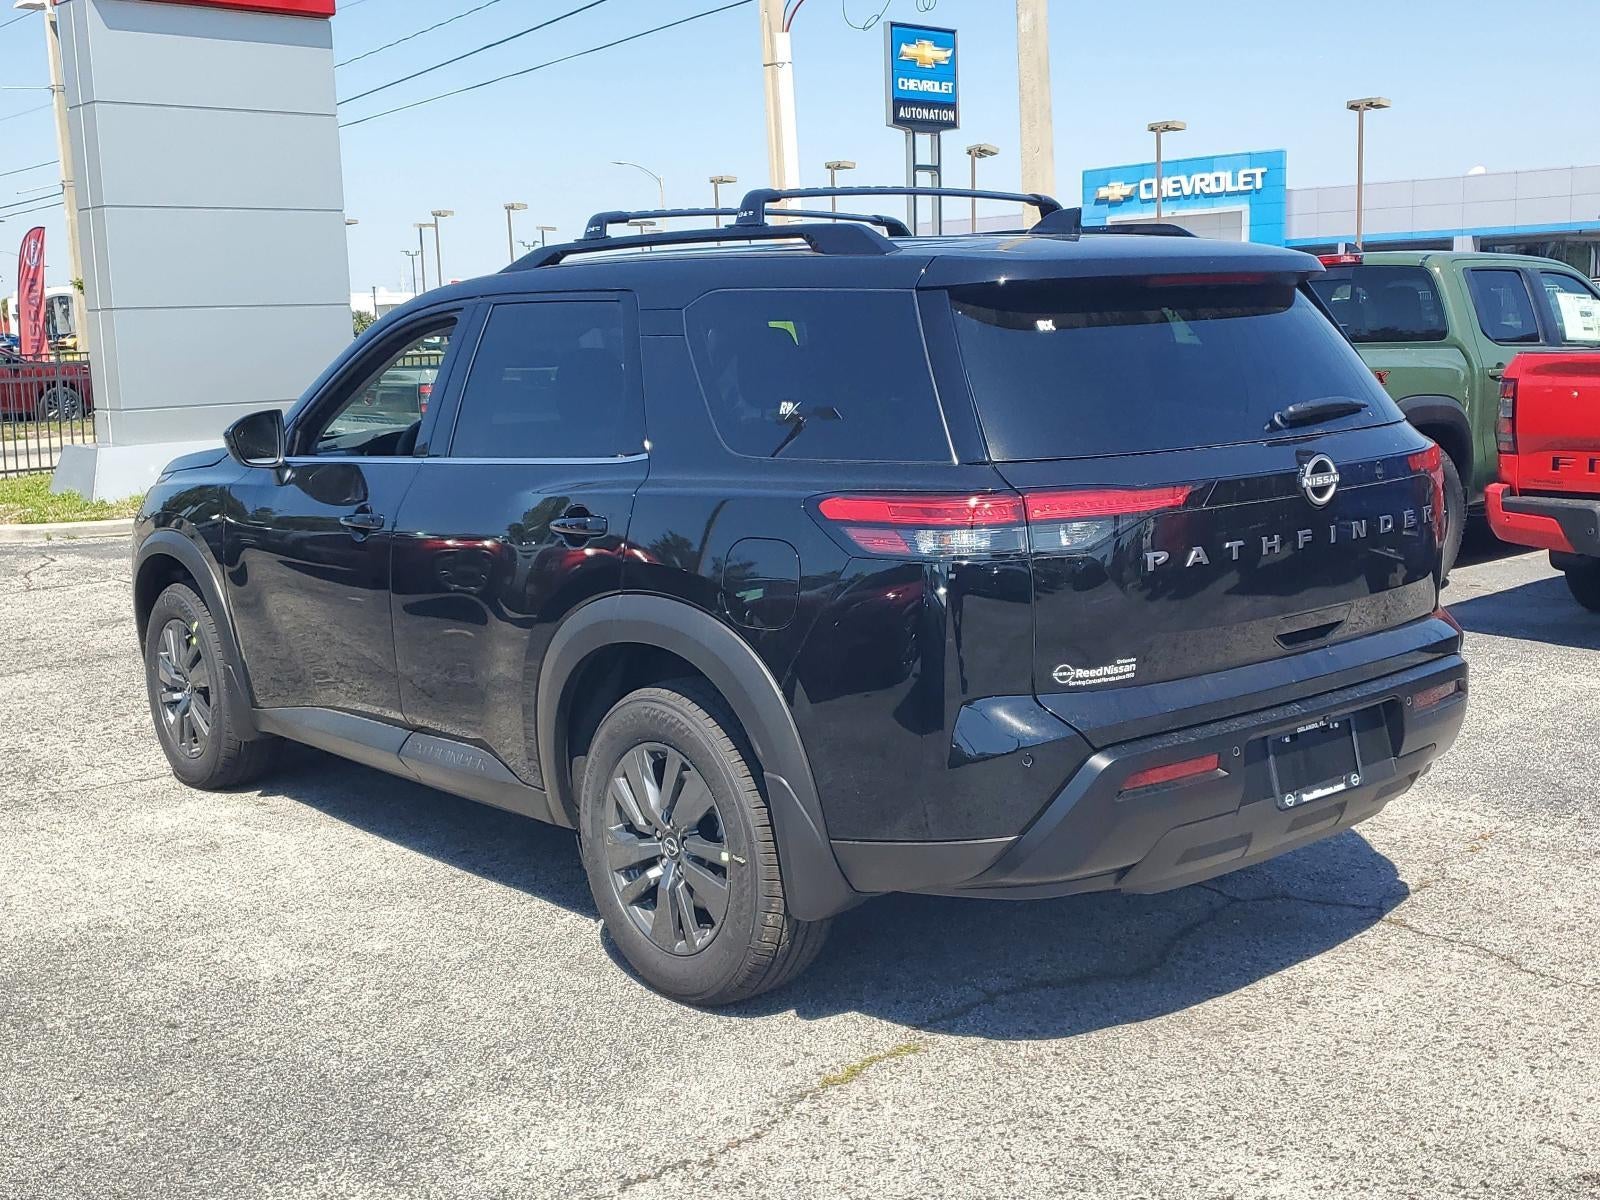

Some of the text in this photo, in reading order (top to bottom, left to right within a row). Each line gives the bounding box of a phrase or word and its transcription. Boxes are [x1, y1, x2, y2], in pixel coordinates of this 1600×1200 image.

[898, 77, 954, 94] CHEVROLET
[899, 106, 955, 122] AUTONATION
[1139, 167, 1268, 200] CHEVROLET
[1303, 473, 1339, 487] NISSAN
[1145, 504, 1433, 571] PATHFINDER
